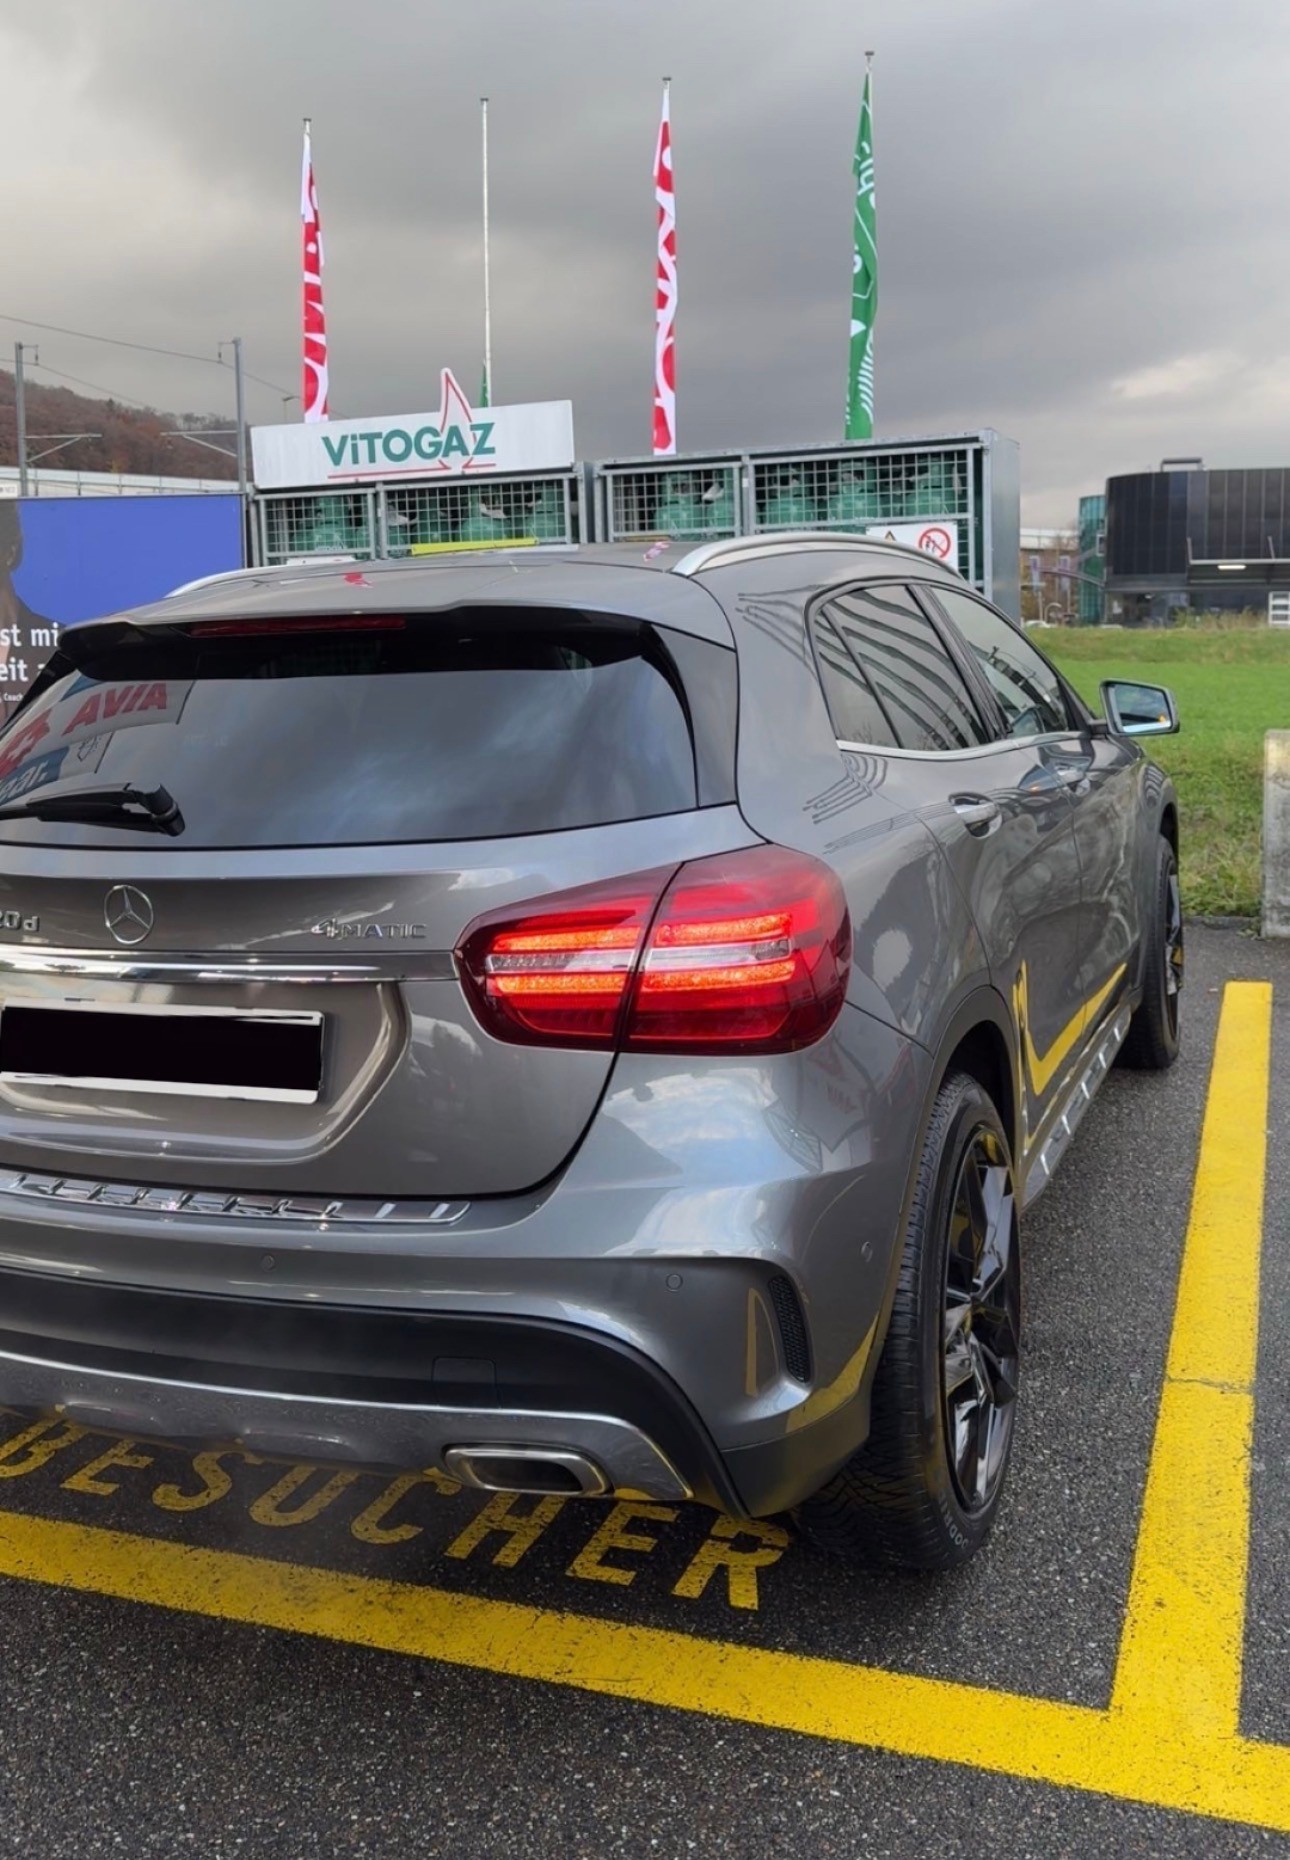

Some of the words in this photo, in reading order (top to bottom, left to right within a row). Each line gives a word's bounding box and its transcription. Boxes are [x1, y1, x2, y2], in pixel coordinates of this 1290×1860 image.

[61, 682, 167, 736] AVIA
[310, 917, 428, 939] 4MATIC
[0, 1417, 790, 1611] BESUCHER
